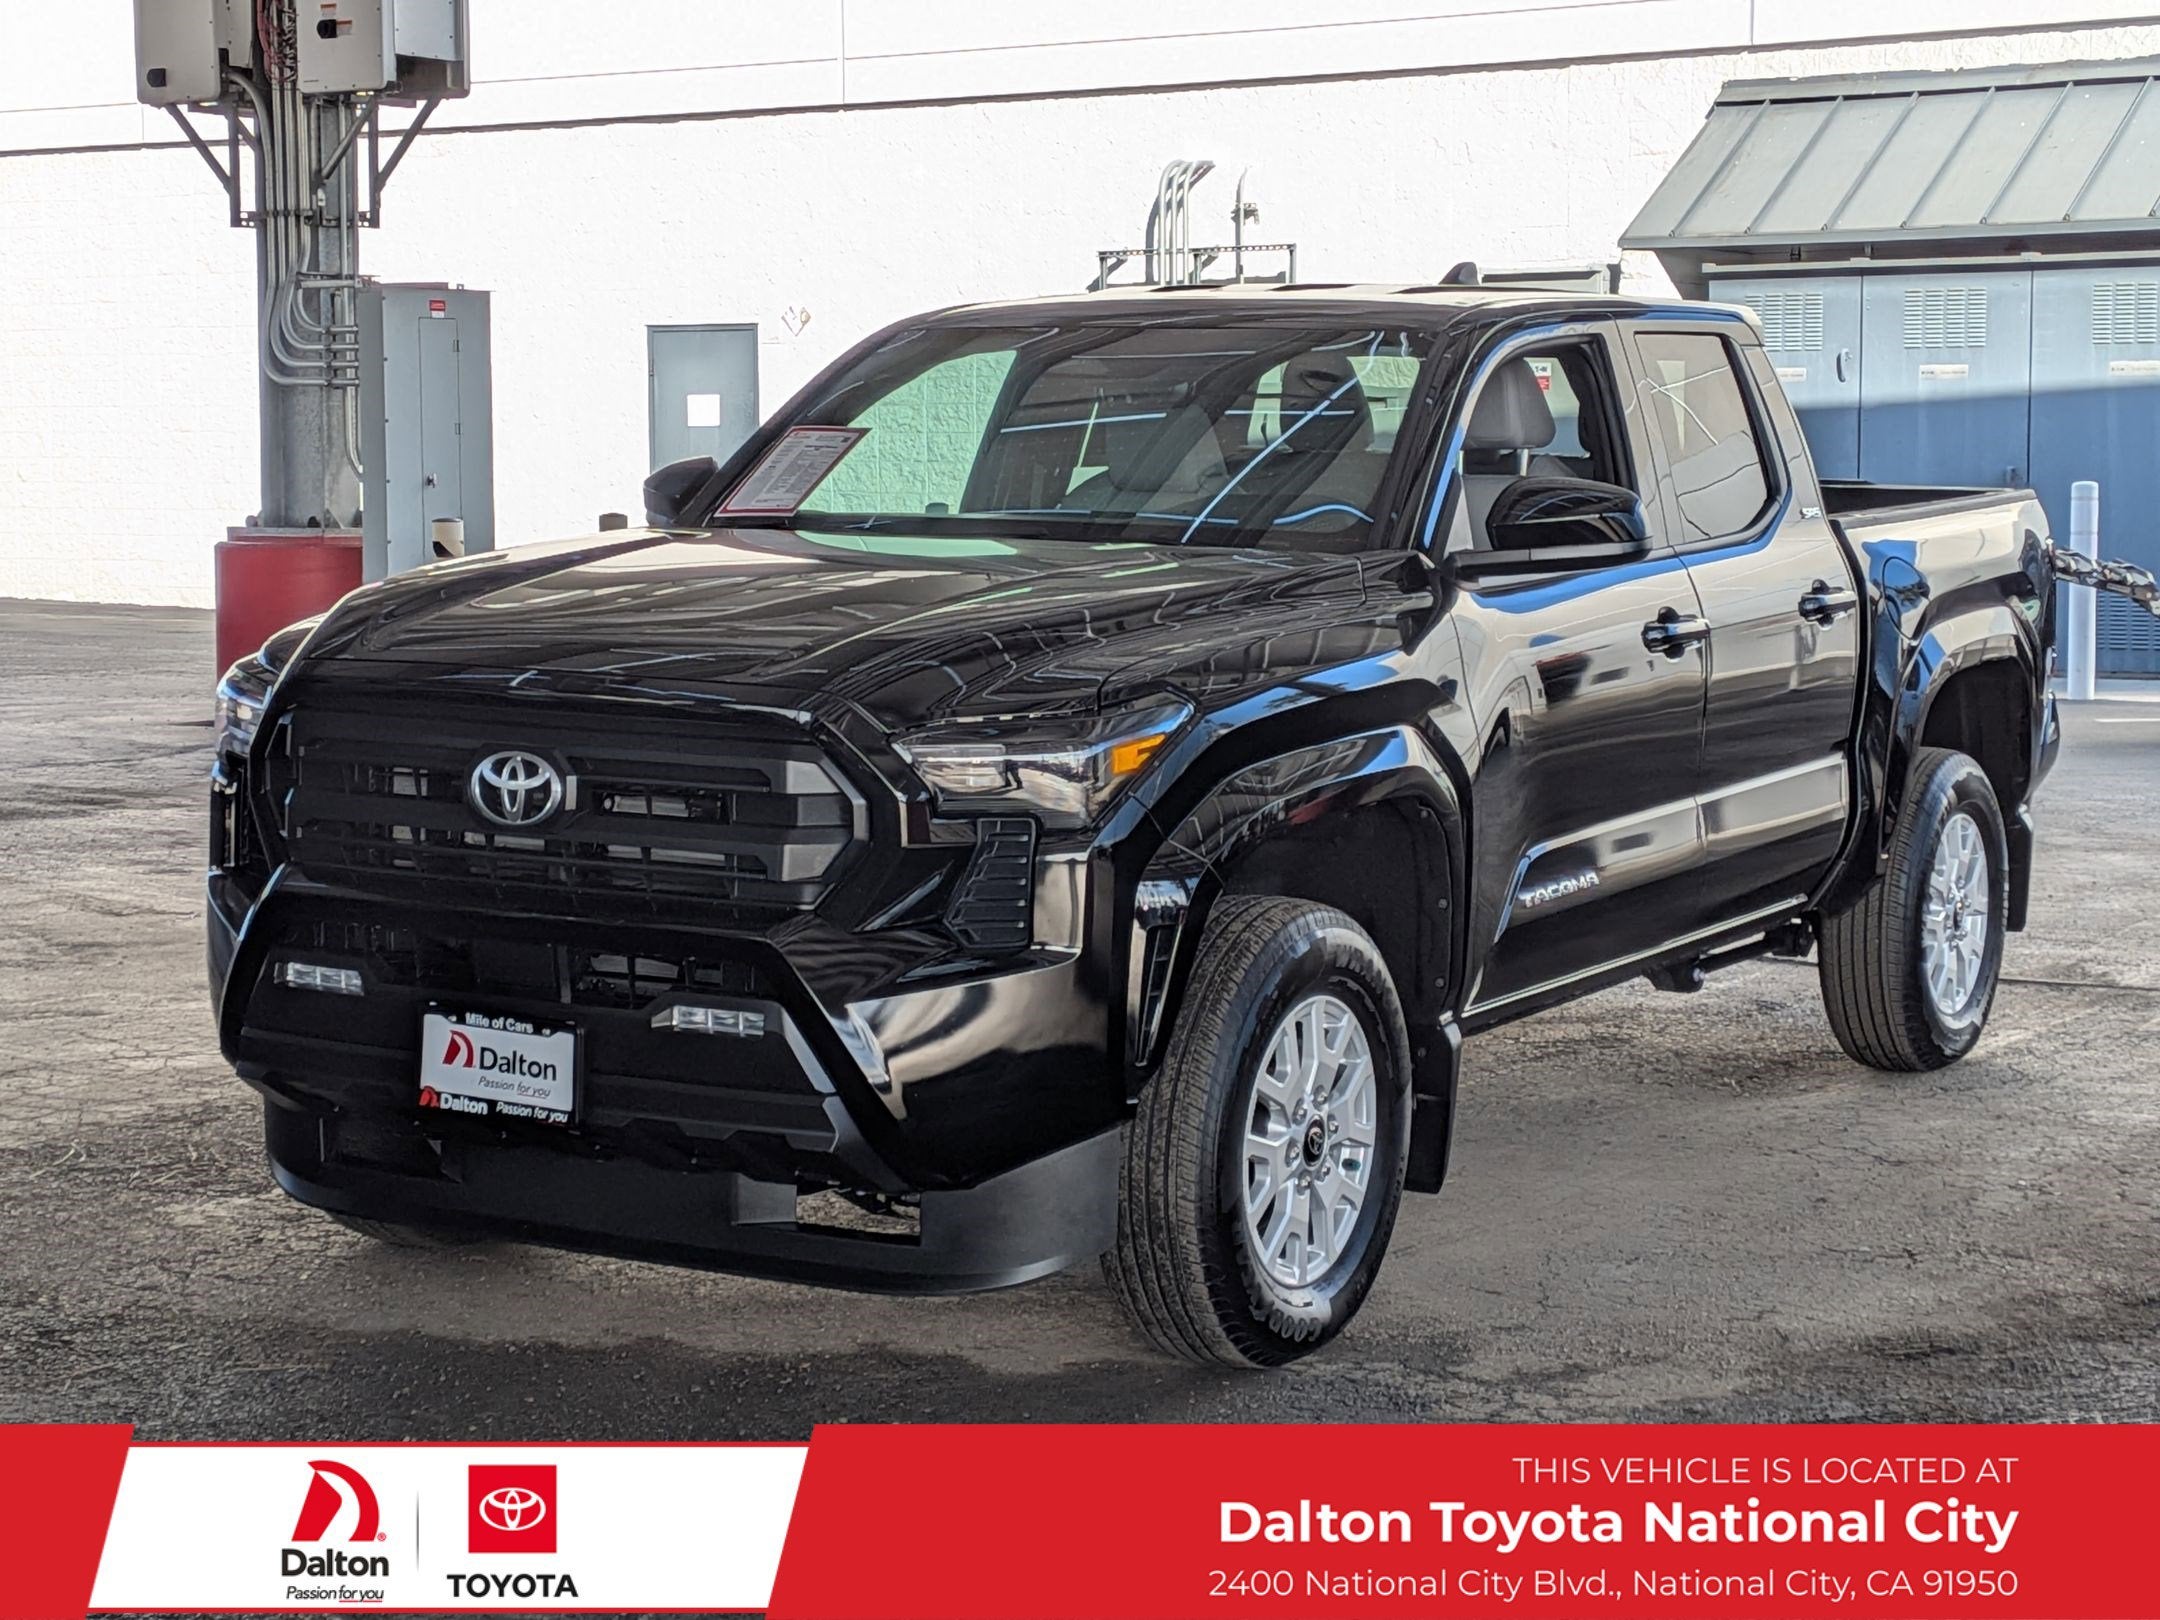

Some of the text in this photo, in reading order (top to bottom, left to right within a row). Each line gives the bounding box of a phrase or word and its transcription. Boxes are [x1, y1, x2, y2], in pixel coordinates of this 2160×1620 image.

[1518, 871, 1600, 908] TACOMA
[465, 1012, 534, 1034] Mile of Cars
[479, 1046, 557, 1081] Dalton
[478, 1076, 551, 1099] Passion for you
[440, 1093, 488, 1115] Dalton
[495, 1101, 569, 1124] Passion for you
